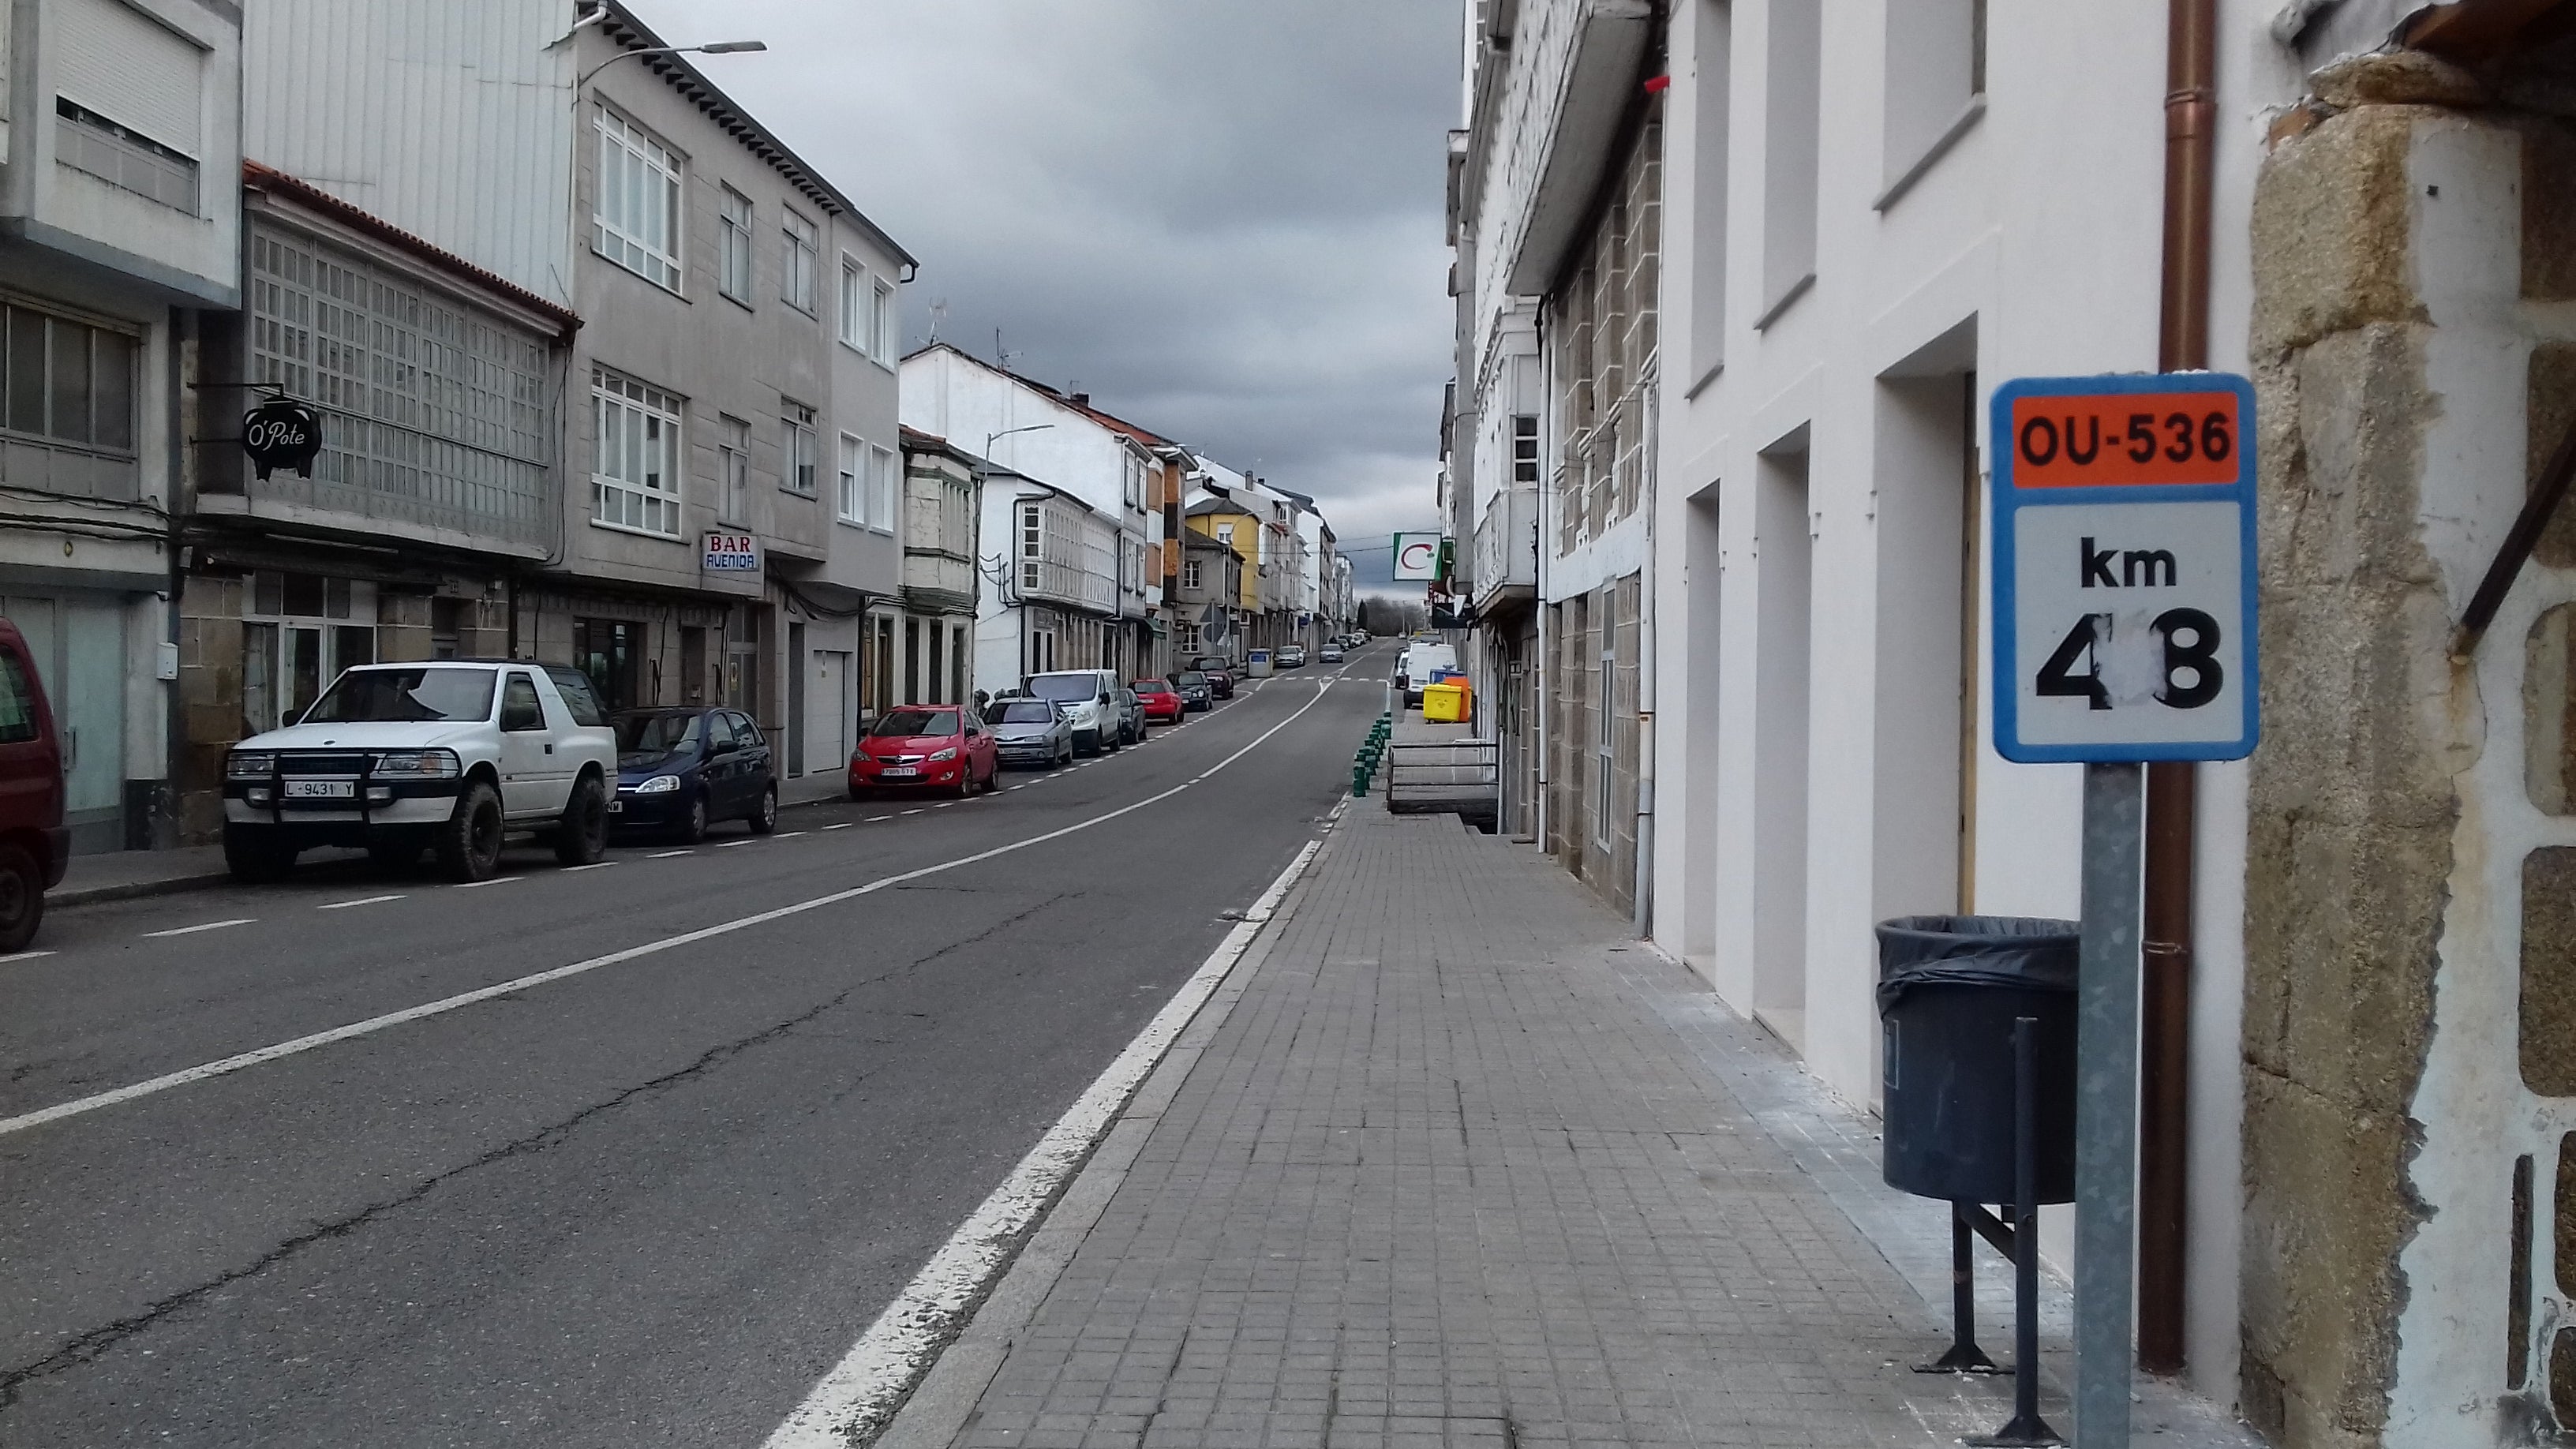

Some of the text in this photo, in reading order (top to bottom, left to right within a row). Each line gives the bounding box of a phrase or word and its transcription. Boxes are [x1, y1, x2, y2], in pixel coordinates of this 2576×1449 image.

[2020, 411, 2232, 466] OU-536
[706, 554, 754, 568] AVENIDA
[710, 536, 751, 552] BAR
[2080, 536, 2177, 588] km
